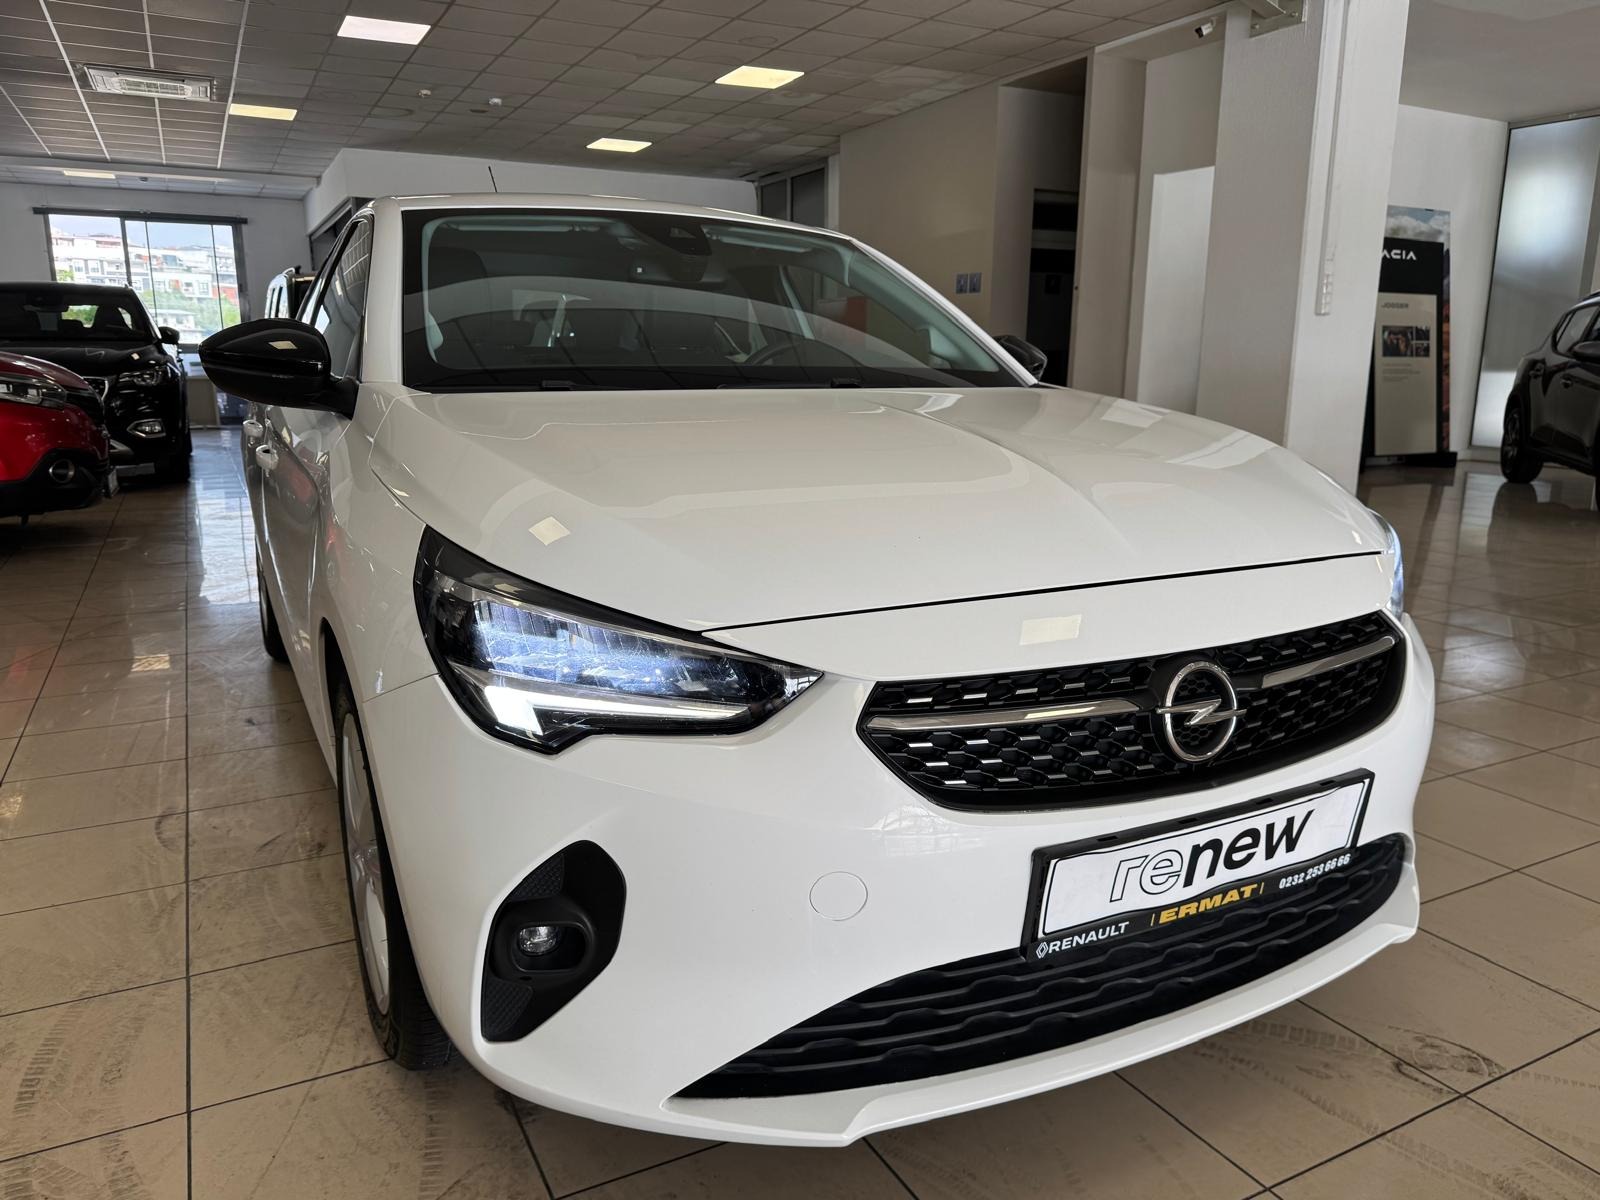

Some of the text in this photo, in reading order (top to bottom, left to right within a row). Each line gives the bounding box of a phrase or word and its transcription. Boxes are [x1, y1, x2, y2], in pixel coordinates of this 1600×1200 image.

[1381, 249, 1416, 260] ACIA
[1110, 809, 1314, 902] renew
[1048, 921, 1129, 953] RENAULT
[1159, 884, 1258, 924] ERMAT
[1279, 872, 1305, 889] 0232
